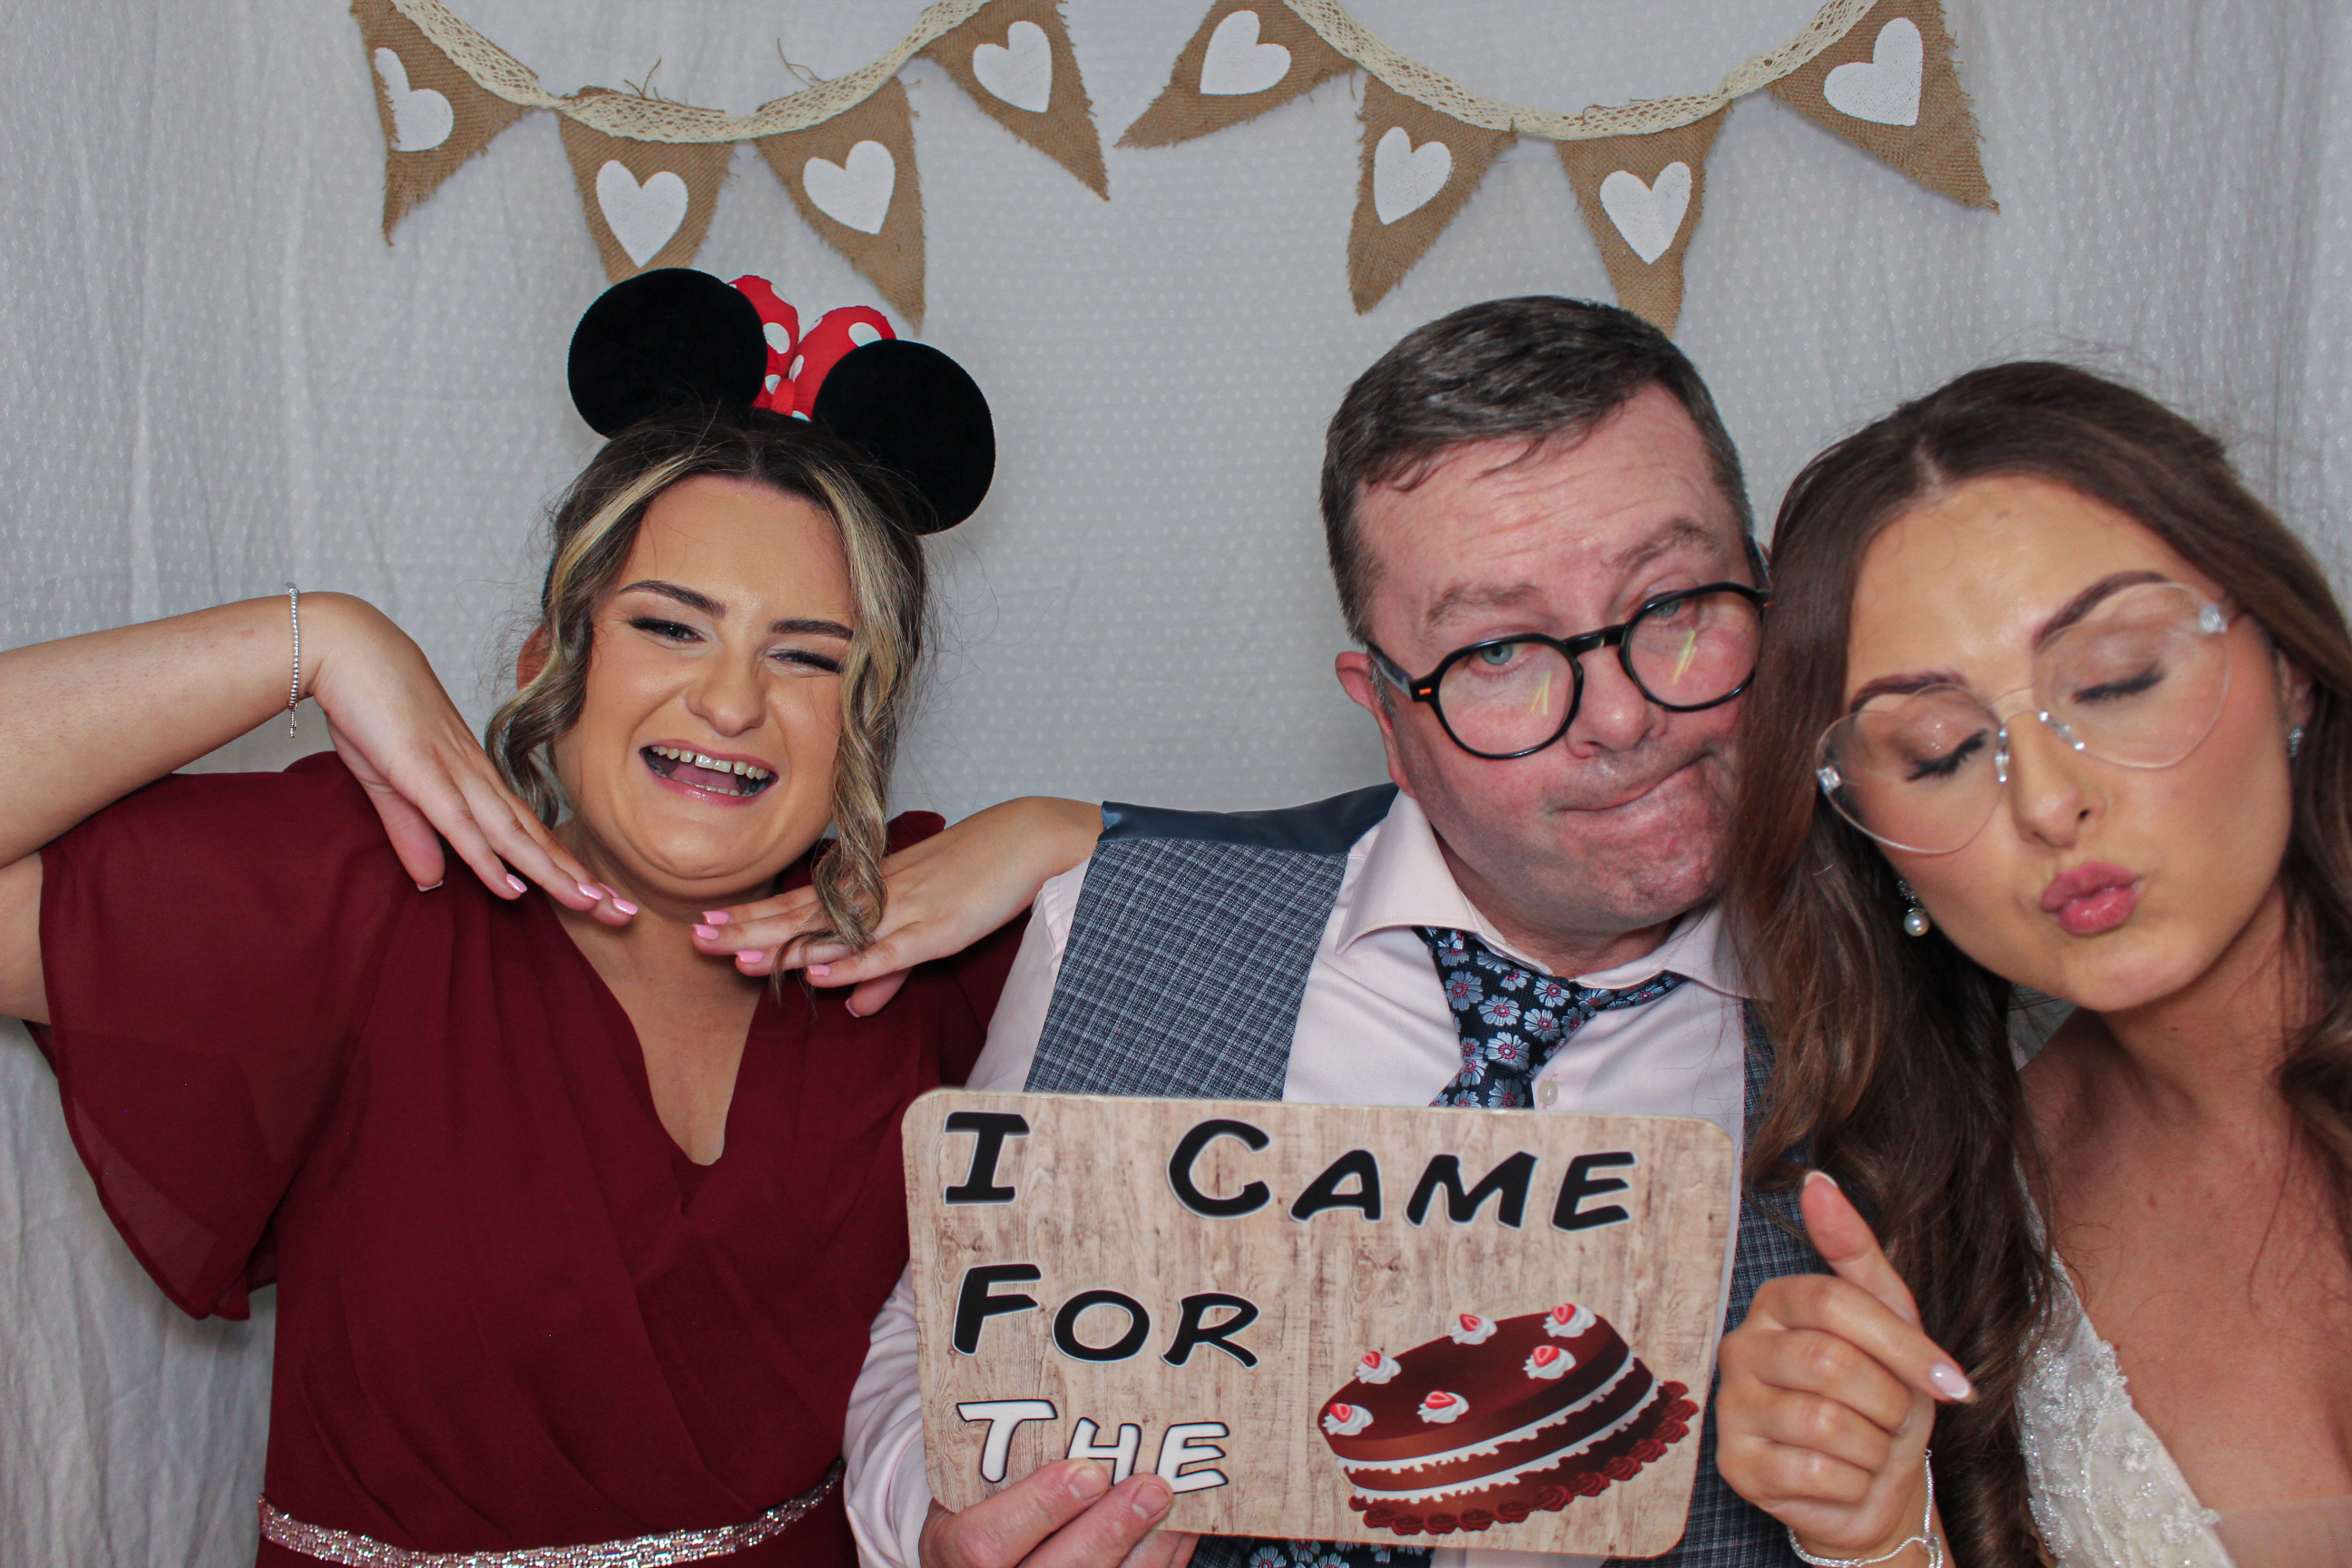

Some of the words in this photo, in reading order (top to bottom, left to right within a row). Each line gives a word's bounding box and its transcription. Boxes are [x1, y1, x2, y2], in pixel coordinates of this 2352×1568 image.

[945, 1112, 1030, 1205] I
[1167, 1118, 1636, 1231] CAME
[951, 1263, 1259, 1369] FOR
[956, 1399, 1230, 1494] THE
